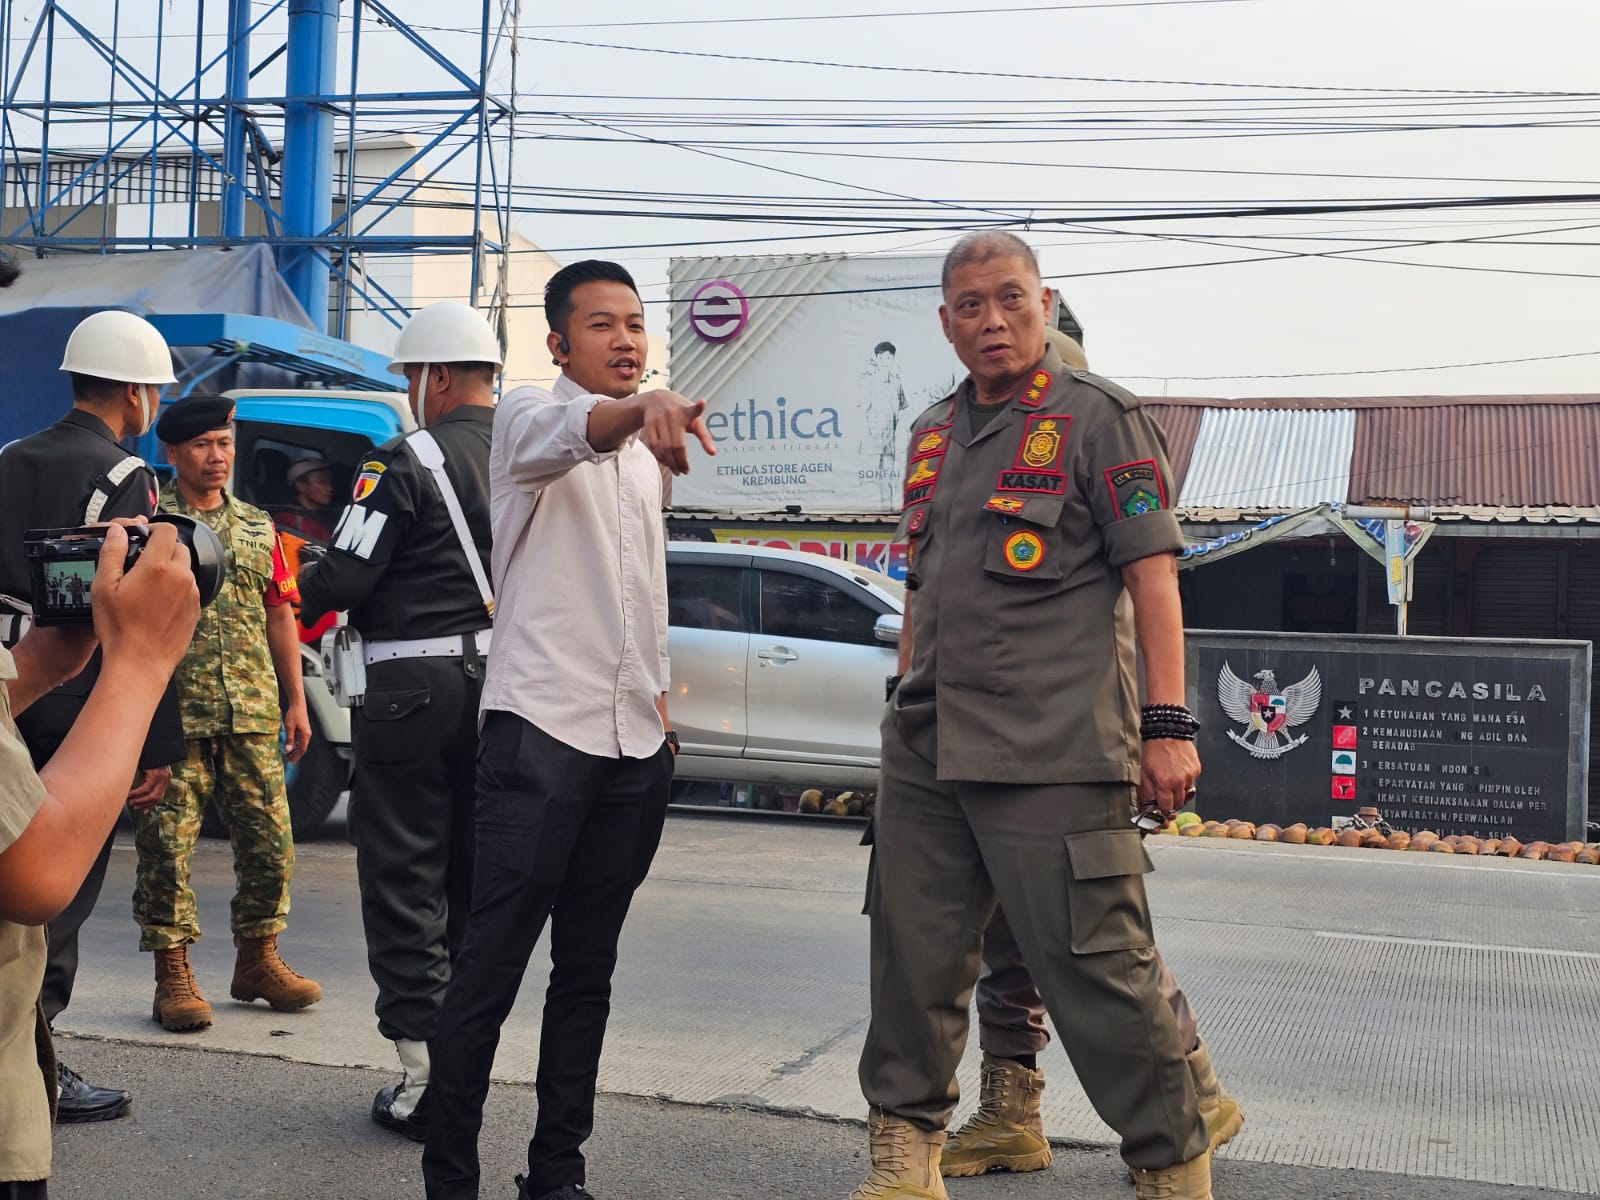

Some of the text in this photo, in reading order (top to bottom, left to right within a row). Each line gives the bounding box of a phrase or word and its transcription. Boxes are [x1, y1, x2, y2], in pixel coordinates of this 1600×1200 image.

[705, 396, 842, 442] ethica
[716, 462, 833, 476] ETHICA STORE AGEN
[742, 474, 807, 486] KREMBUNG
[1001, 474, 1061, 491] KASAT
[1359, 678, 1547, 701] PANCASILA
[1364, 709, 1526, 724] 1 KETUHANAN YANG MAHA ESA
[1362, 726, 1368, 736] 2
[1373, 727, 1442, 739] KEMANUSIAAN
[1479, 732, 1501, 741] ADIL
[1507, 733, 1527, 743] DAN
[1372, 741, 1416, 751] BERADAB
[1362, 760, 1368, 769] 3
[1440, 781, 1464, 792] YANG
[1514, 786, 1540, 796] OLEH
[1493, 800, 1523, 810] DALAM
